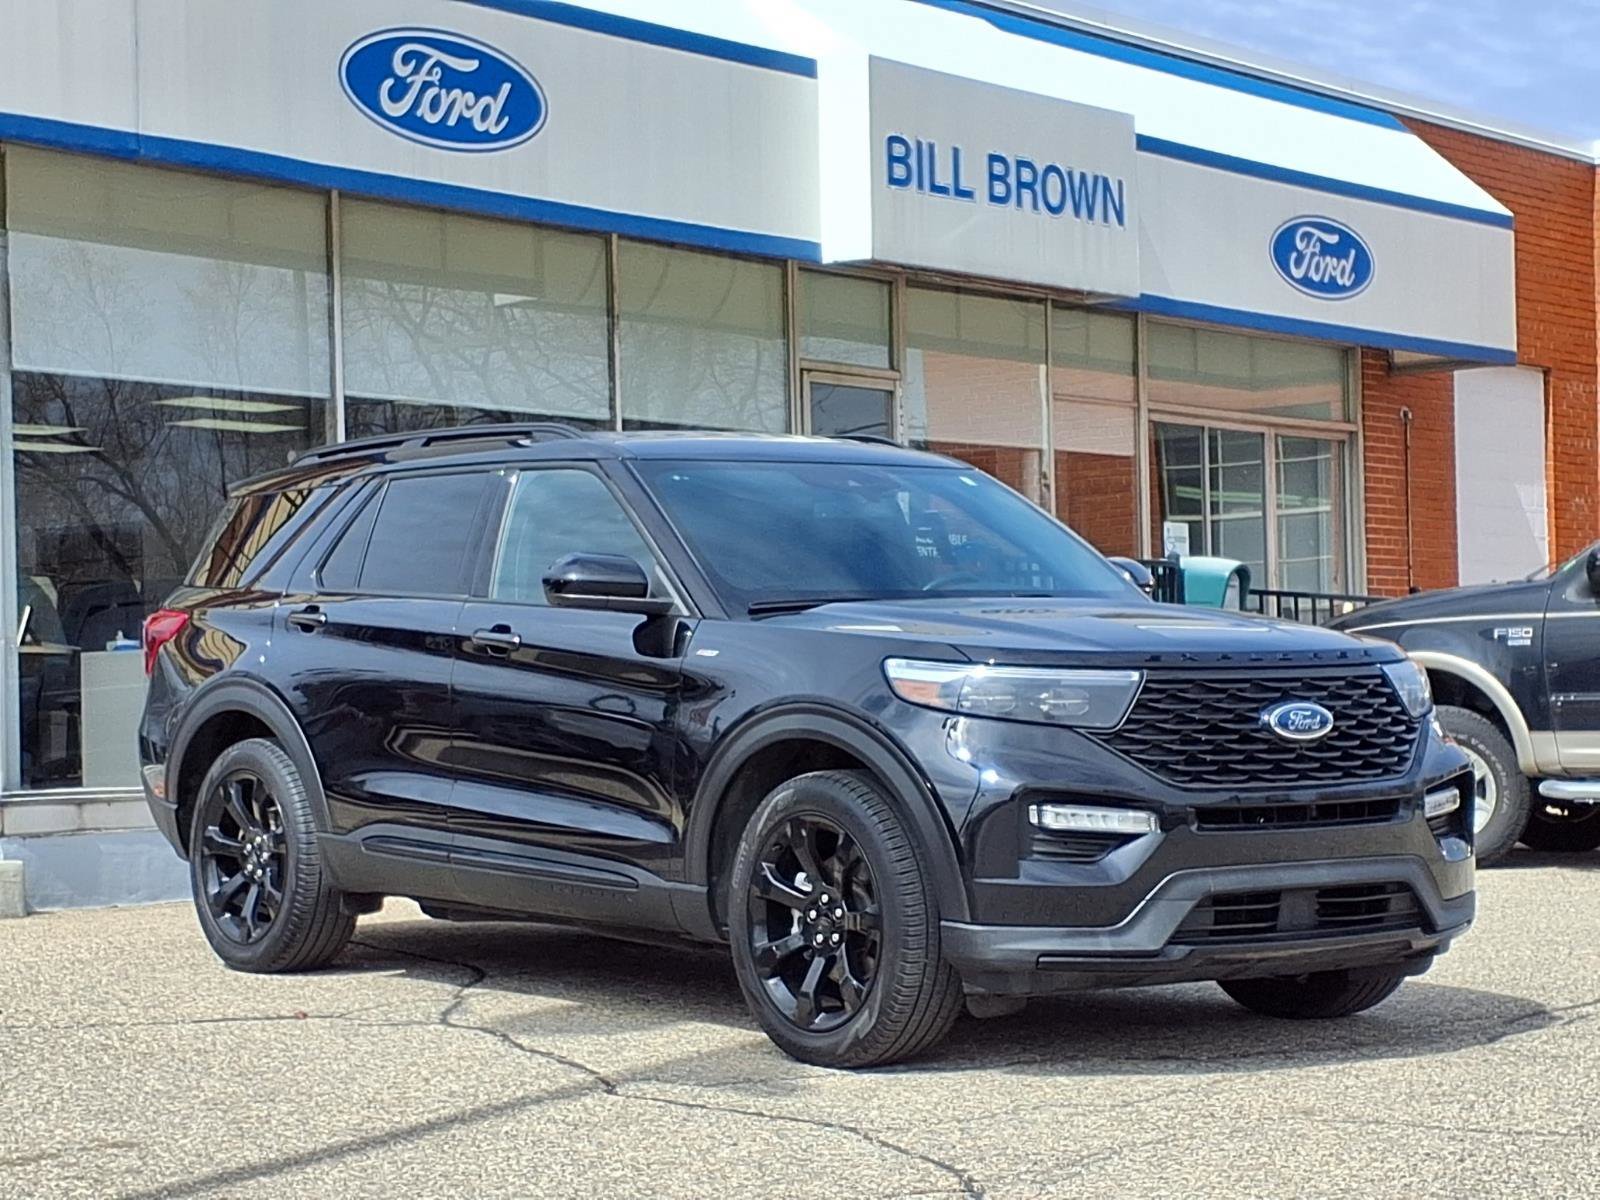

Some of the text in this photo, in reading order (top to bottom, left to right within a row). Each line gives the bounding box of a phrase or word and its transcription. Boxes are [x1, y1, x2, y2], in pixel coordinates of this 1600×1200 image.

[380, 43, 512, 134] Ford
[886, 134, 1125, 227] BILL BROWN
[1289, 226, 1356, 287] Ford
[1288, 710, 1321, 730] Ford
